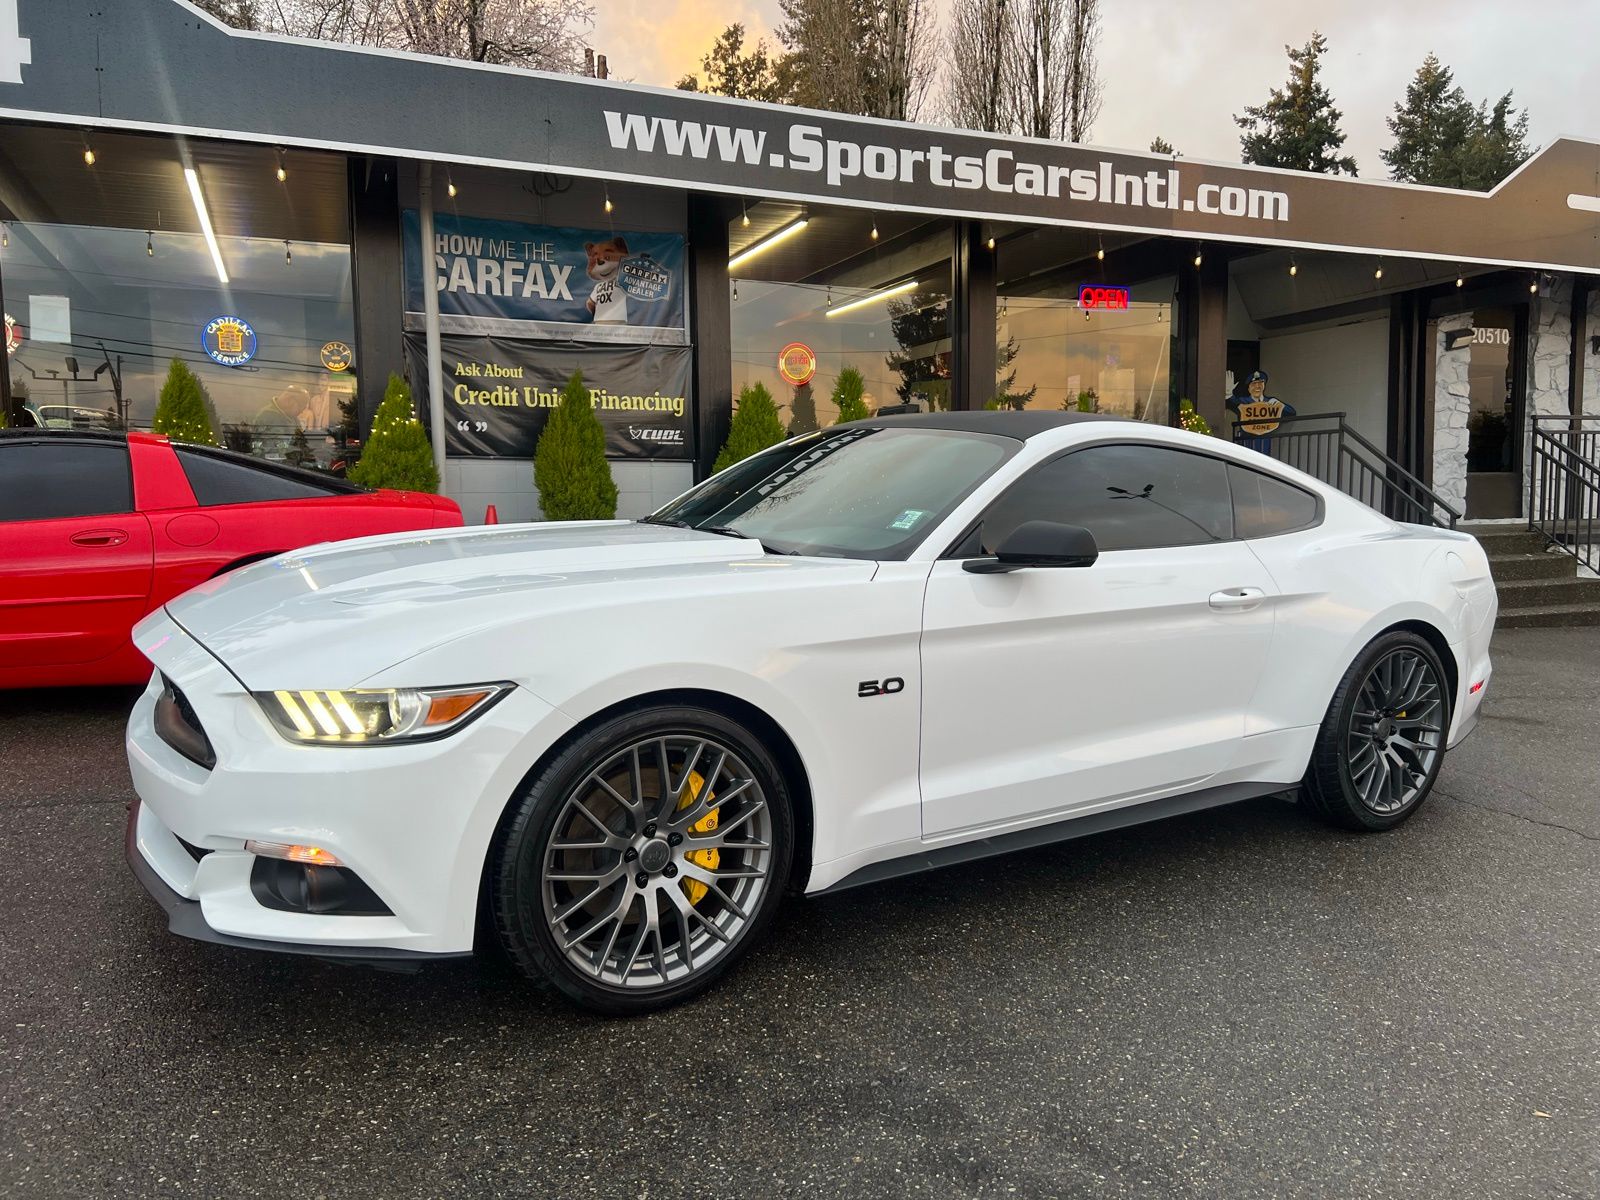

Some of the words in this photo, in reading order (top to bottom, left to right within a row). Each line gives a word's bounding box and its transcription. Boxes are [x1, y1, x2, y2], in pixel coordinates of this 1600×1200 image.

[603, 110, 1289, 221] www.SportsCarsIntl.com
[435, 233, 483, 256] HOW
[489, 238, 517, 259] ME
[521, 241, 555, 262] THE
[623, 264, 668, 284] CARFAX
[624, 275, 662, 292] ADVANTAGE
[627, 284, 654, 299] DEALER
[596, 292, 612, 304] FOX
[1081, 287, 1128, 310] OPEN
[207, 317, 253, 337] CADILLAC
[1471, 327, 1509, 344] 20510
[211, 350, 250, 364] SERVICE
[455, 362, 481, 377] Ask
[484, 363, 523, 378] About
[454, 384, 519, 407] Credit
[524, 387, 567, 408] Uni
[589, 389, 684, 417] Financing
[1245, 406, 1279, 418] SLOW
[858, 676, 905, 698] 5.0
